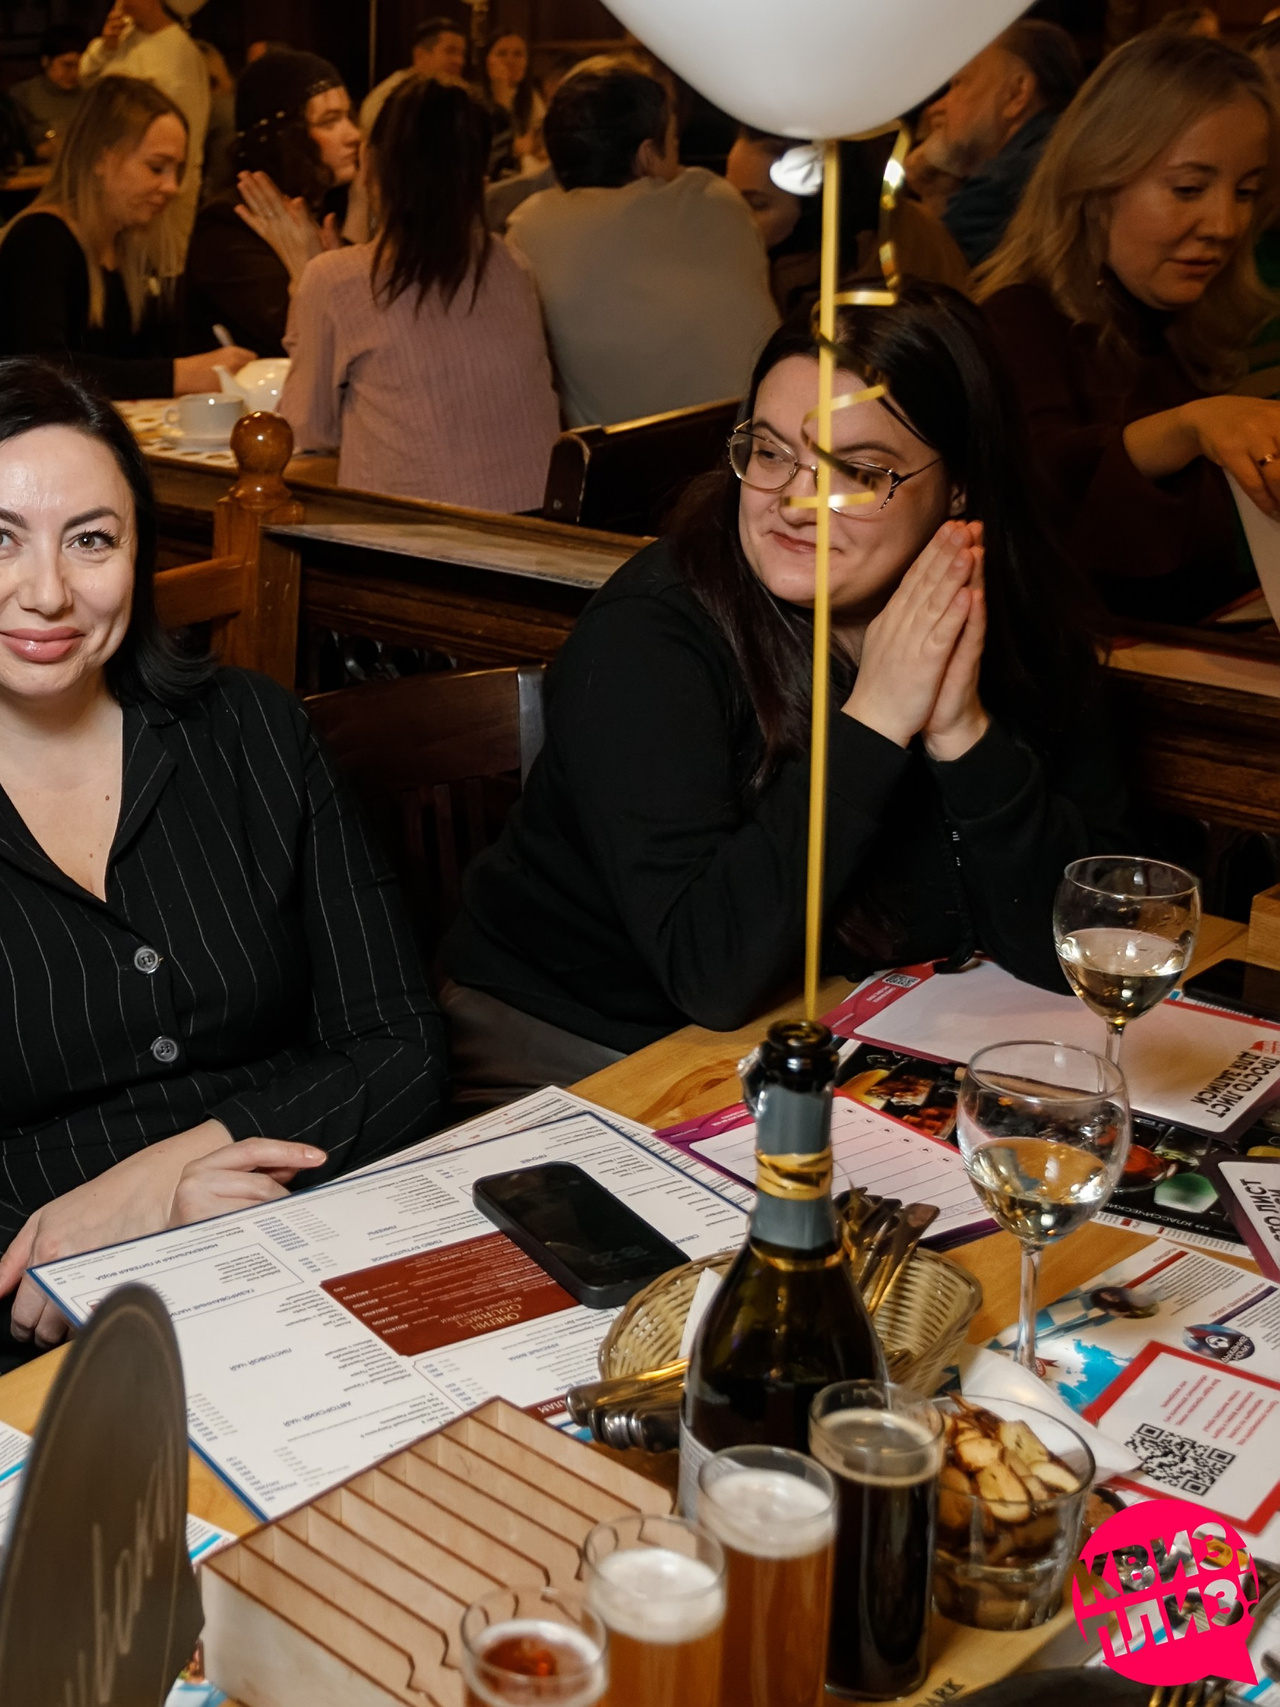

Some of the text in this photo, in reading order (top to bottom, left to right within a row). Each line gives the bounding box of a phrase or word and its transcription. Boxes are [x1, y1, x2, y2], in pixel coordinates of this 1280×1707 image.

[1190, 1049, 1261, 1106] ДЛЯ ЗАПИСИ
[1206, 1056, 1280, 1118] ПРОСТО ЛИСТ
[518, 1153, 548, 1163] ПРОЧЕЕ
[1240, 1178, 1279, 1213] ЛИСТ
[365, 1224, 398, 1235] ЛИКЕРЫ
[670, 1233, 701, 1244] СВЕЖЕ
[159, 1242, 219, 1262] МИНЕРАЛЬНАЯ
[368, 1238, 444, 1262] ПИВО БУТЫЛОЧНОЕ
[93, 1271, 118, 1281] ВОДА
[116, 1261, 154, 1274] ПИТЕВАЯ
[166, 1287, 256, 1317] ГАЗИРОВАННЫЕ НАПИ
[437, 1295, 523, 1324] ЯГОДНЫЕ НАСТОЙКИ
[468, 1311, 522, 1331] ОНЕГИН
[227, 1347, 293, 1371] ЛИСТОВОЙ ЧАЙ
[506, 1342, 560, 1361] КРАСНЫЕ ВИНА
[552, 1374, 599, 1392] БЕЛЫЕ ВИНА
[281, 1400, 353, 1427] АВТОРСКИЙ ЧАЙ
[535, 1398, 569, 1413] АЛАМ
[916, 1678, 965, 1707] ARK
